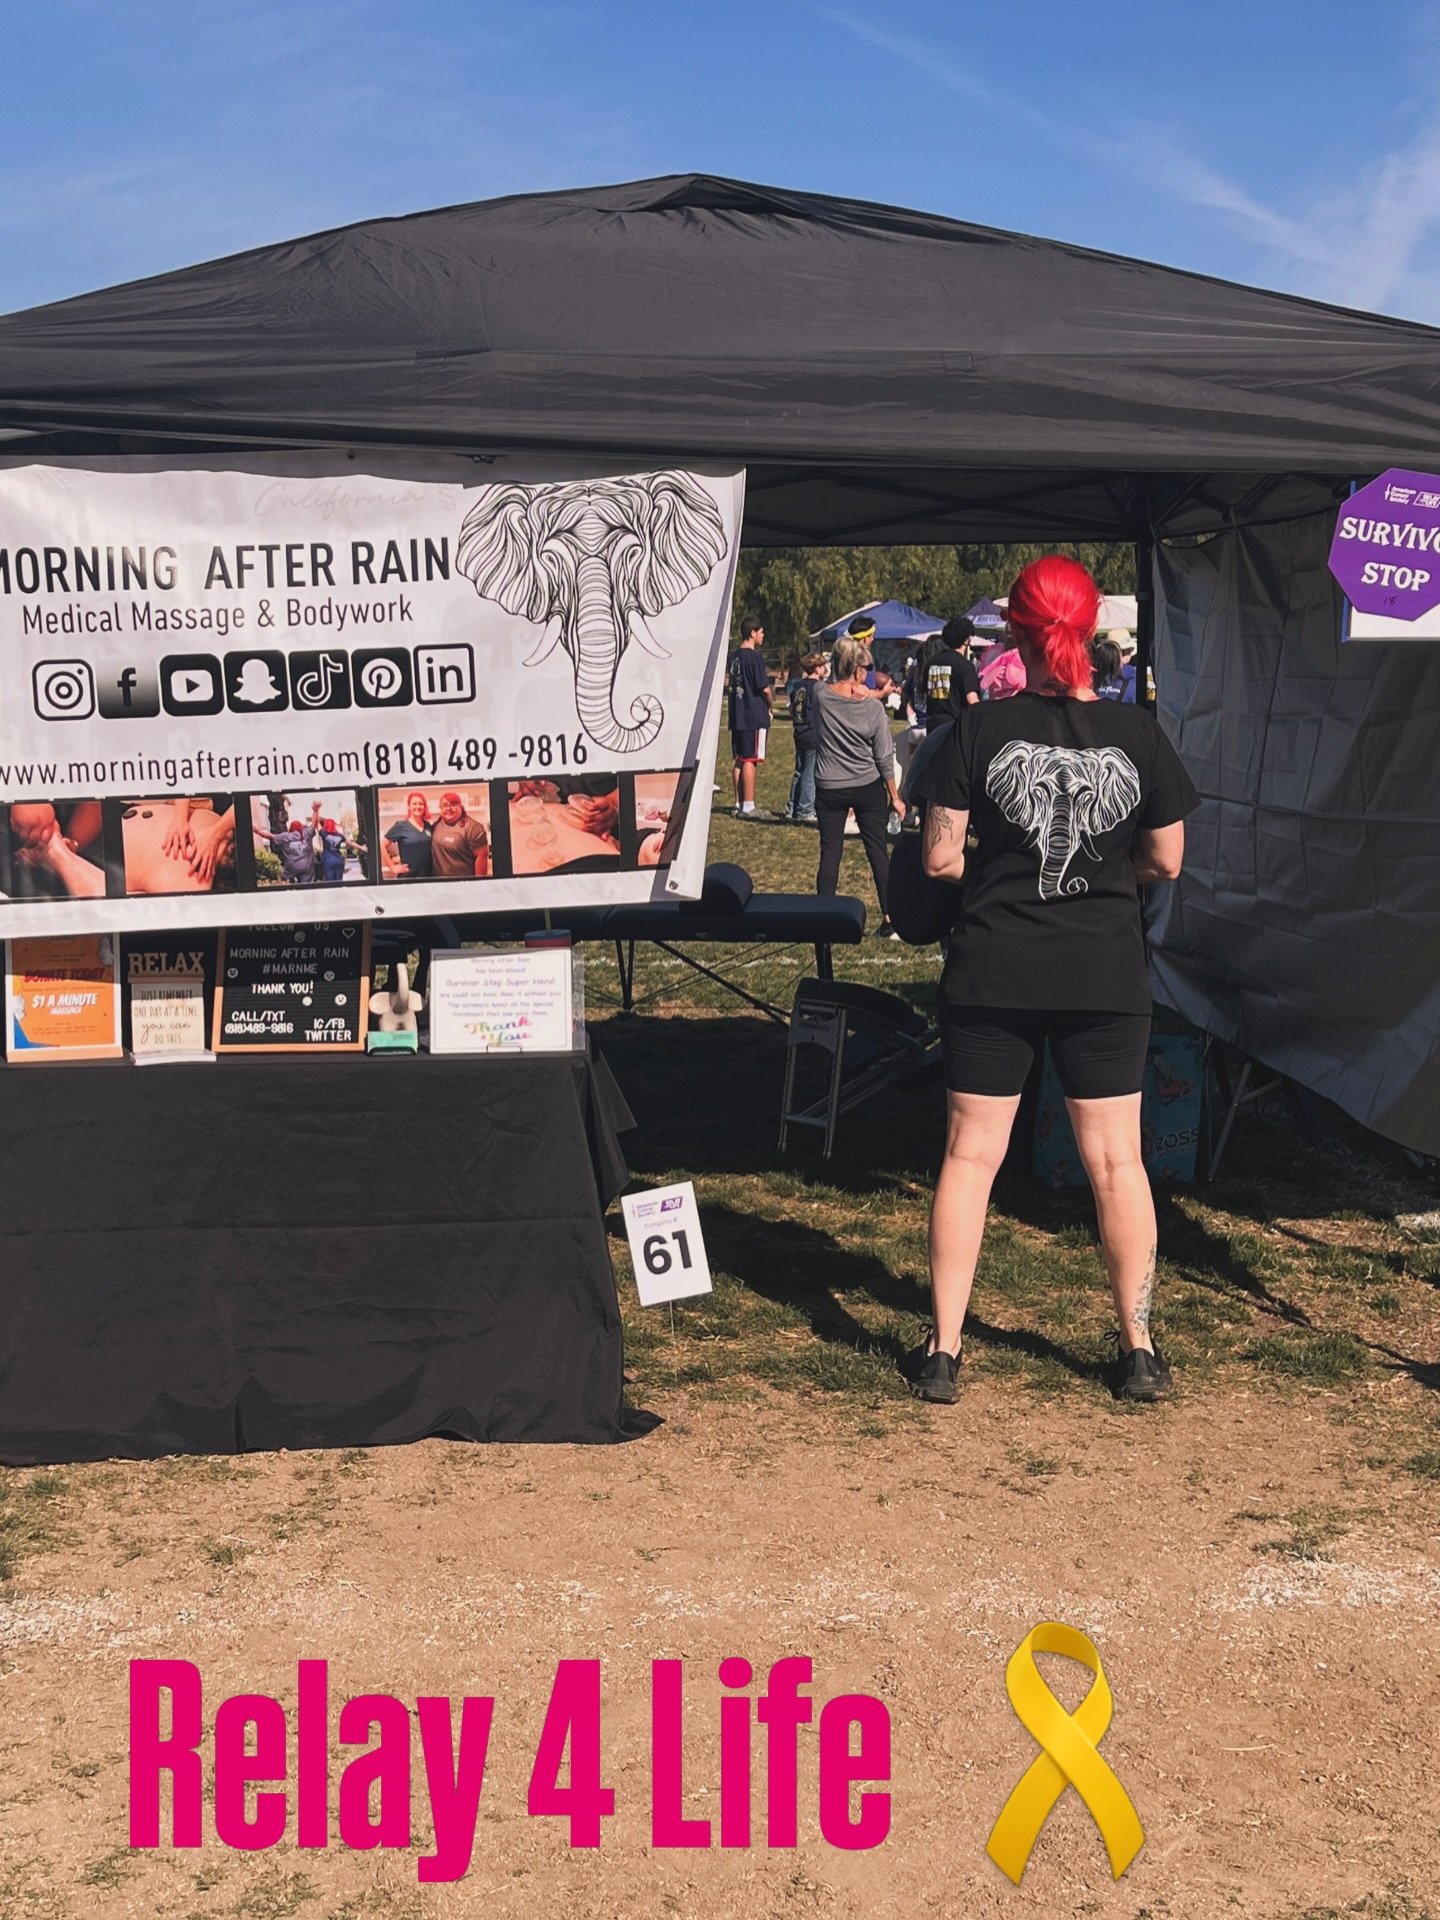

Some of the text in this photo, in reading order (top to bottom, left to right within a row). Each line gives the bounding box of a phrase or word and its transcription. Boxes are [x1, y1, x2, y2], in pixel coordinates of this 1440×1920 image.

[254, 482, 424, 520] California
[204, 542, 336, 589] AFTER
[351, 537, 450, 585] RAIN
[1361, 561, 1431, 592] STOP
[22, 594, 413, 636] Medical Massage & Bodywork
[363, 738, 437, 779] (818)
[447, 736, 497, 771] 489
[230, 947, 349, 959] MORNING AFTER RAIN
[127, 952, 204, 975] RELAX
[262, 963, 318, 974] #MARNME
[251, 980, 314, 994] THANK YOU!
[445, 978, 480, 987] Survivor
[32, 993, 99, 1008] $1 A MINUTE
[231, 1010, 286, 1022] CALL/TXT
[225, 1022, 294, 1034] (818)489-9816
[464, 1016, 534, 1034] Thank
[142, 1022, 191, 1045] you can
[304, 1030, 351, 1041] TWITTER
[480, 1032, 532, 1046] You
[643, 1229, 693, 1275] 61
